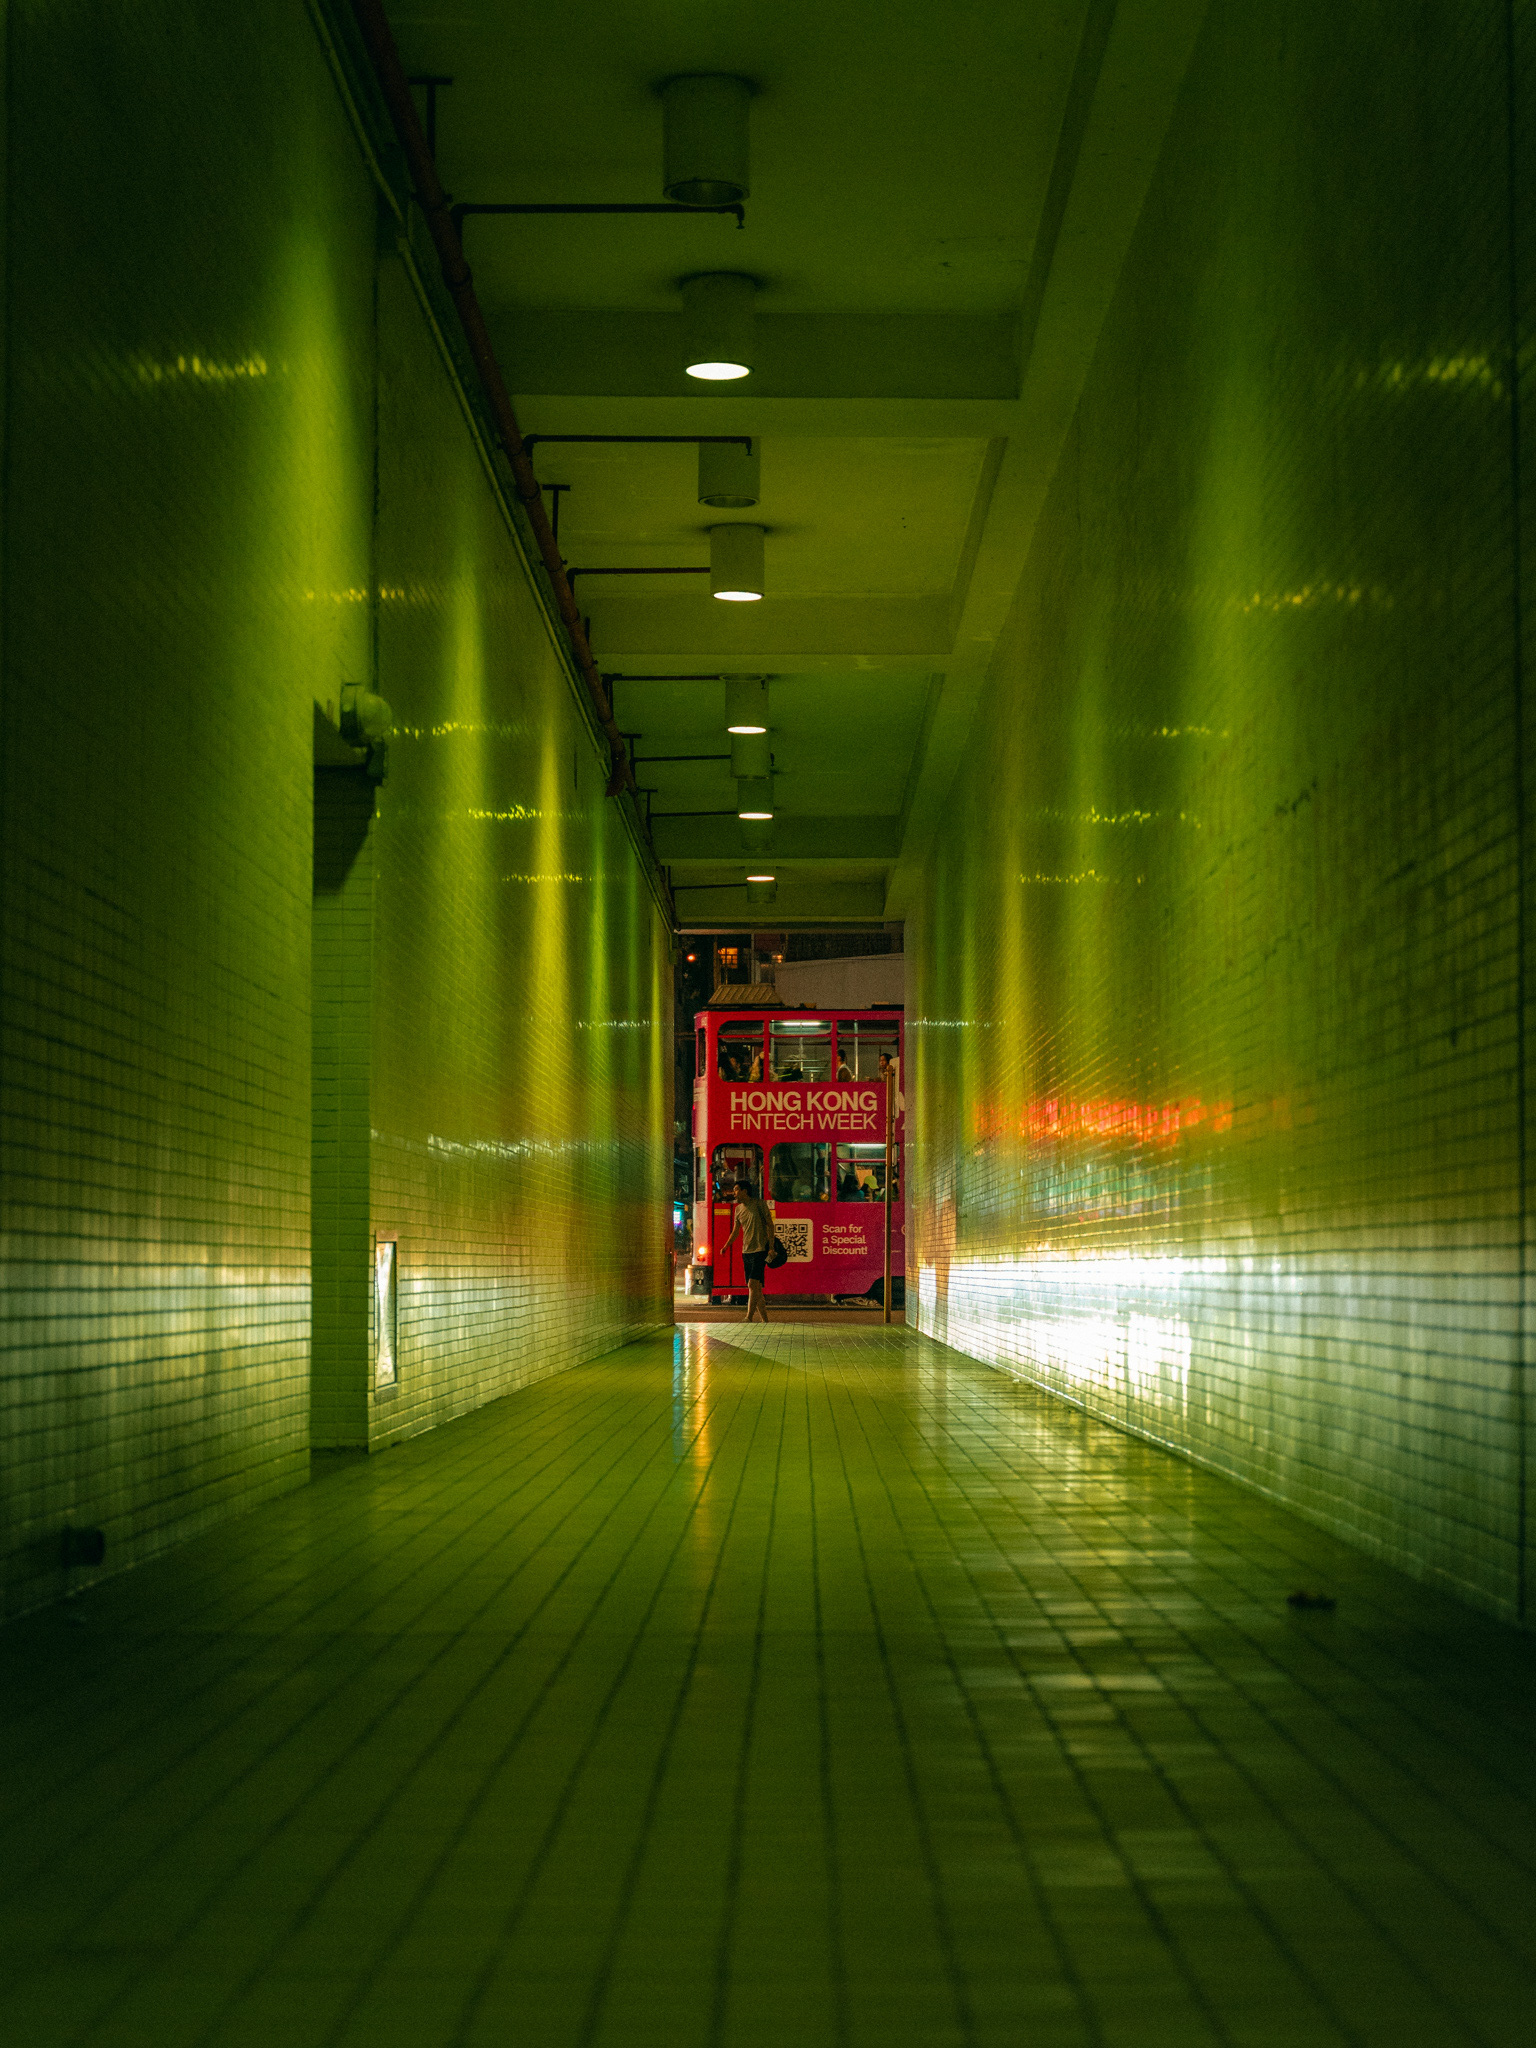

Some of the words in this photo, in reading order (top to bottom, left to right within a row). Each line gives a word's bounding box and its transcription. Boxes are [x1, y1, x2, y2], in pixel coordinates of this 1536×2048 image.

[730, 1091, 801, 1111] HONG
[806, 1091, 877, 1111] KONG
[730, 1113, 814, 1130] FINTECH
[817, 1113, 877, 1130] WEEK
[822, 1224, 847, 1233] Scan
[848, 1224, 863, 1233] for
[822, 1236, 829, 1244] a
[830, 1235, 867, 1246] Special
[822, 1246, 868, 1255] Discount!
